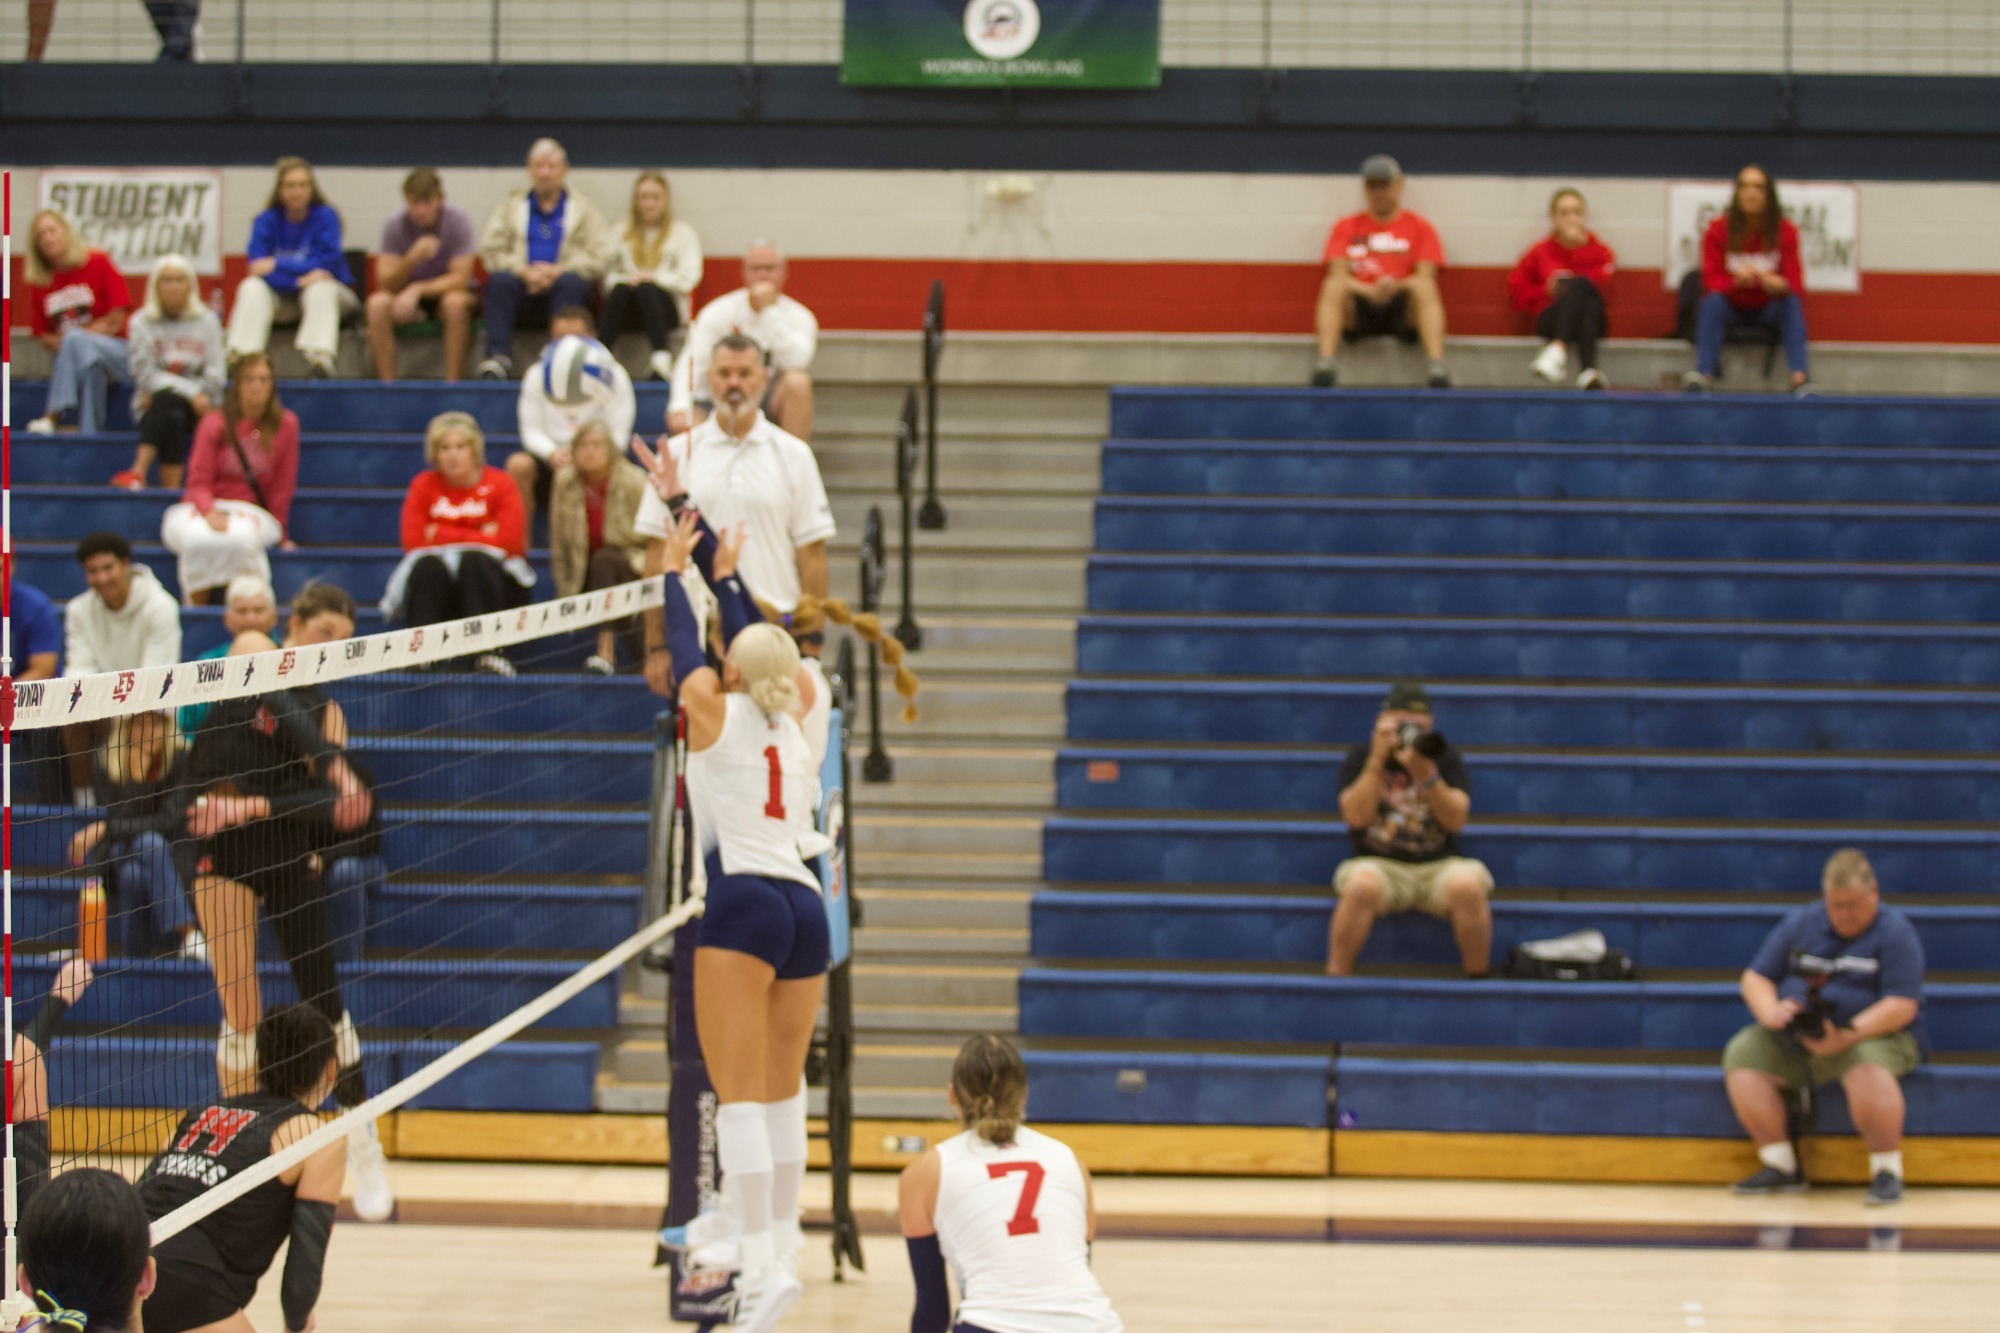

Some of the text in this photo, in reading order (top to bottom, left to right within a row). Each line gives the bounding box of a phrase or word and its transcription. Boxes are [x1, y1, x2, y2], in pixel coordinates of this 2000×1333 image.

[1004, 59, 1084, 78] BOWLING
[51, 183, 209, 218] STUDENT
[764, 745, 786, 821] 1
[986, 1161, 1046, 1237] 7
